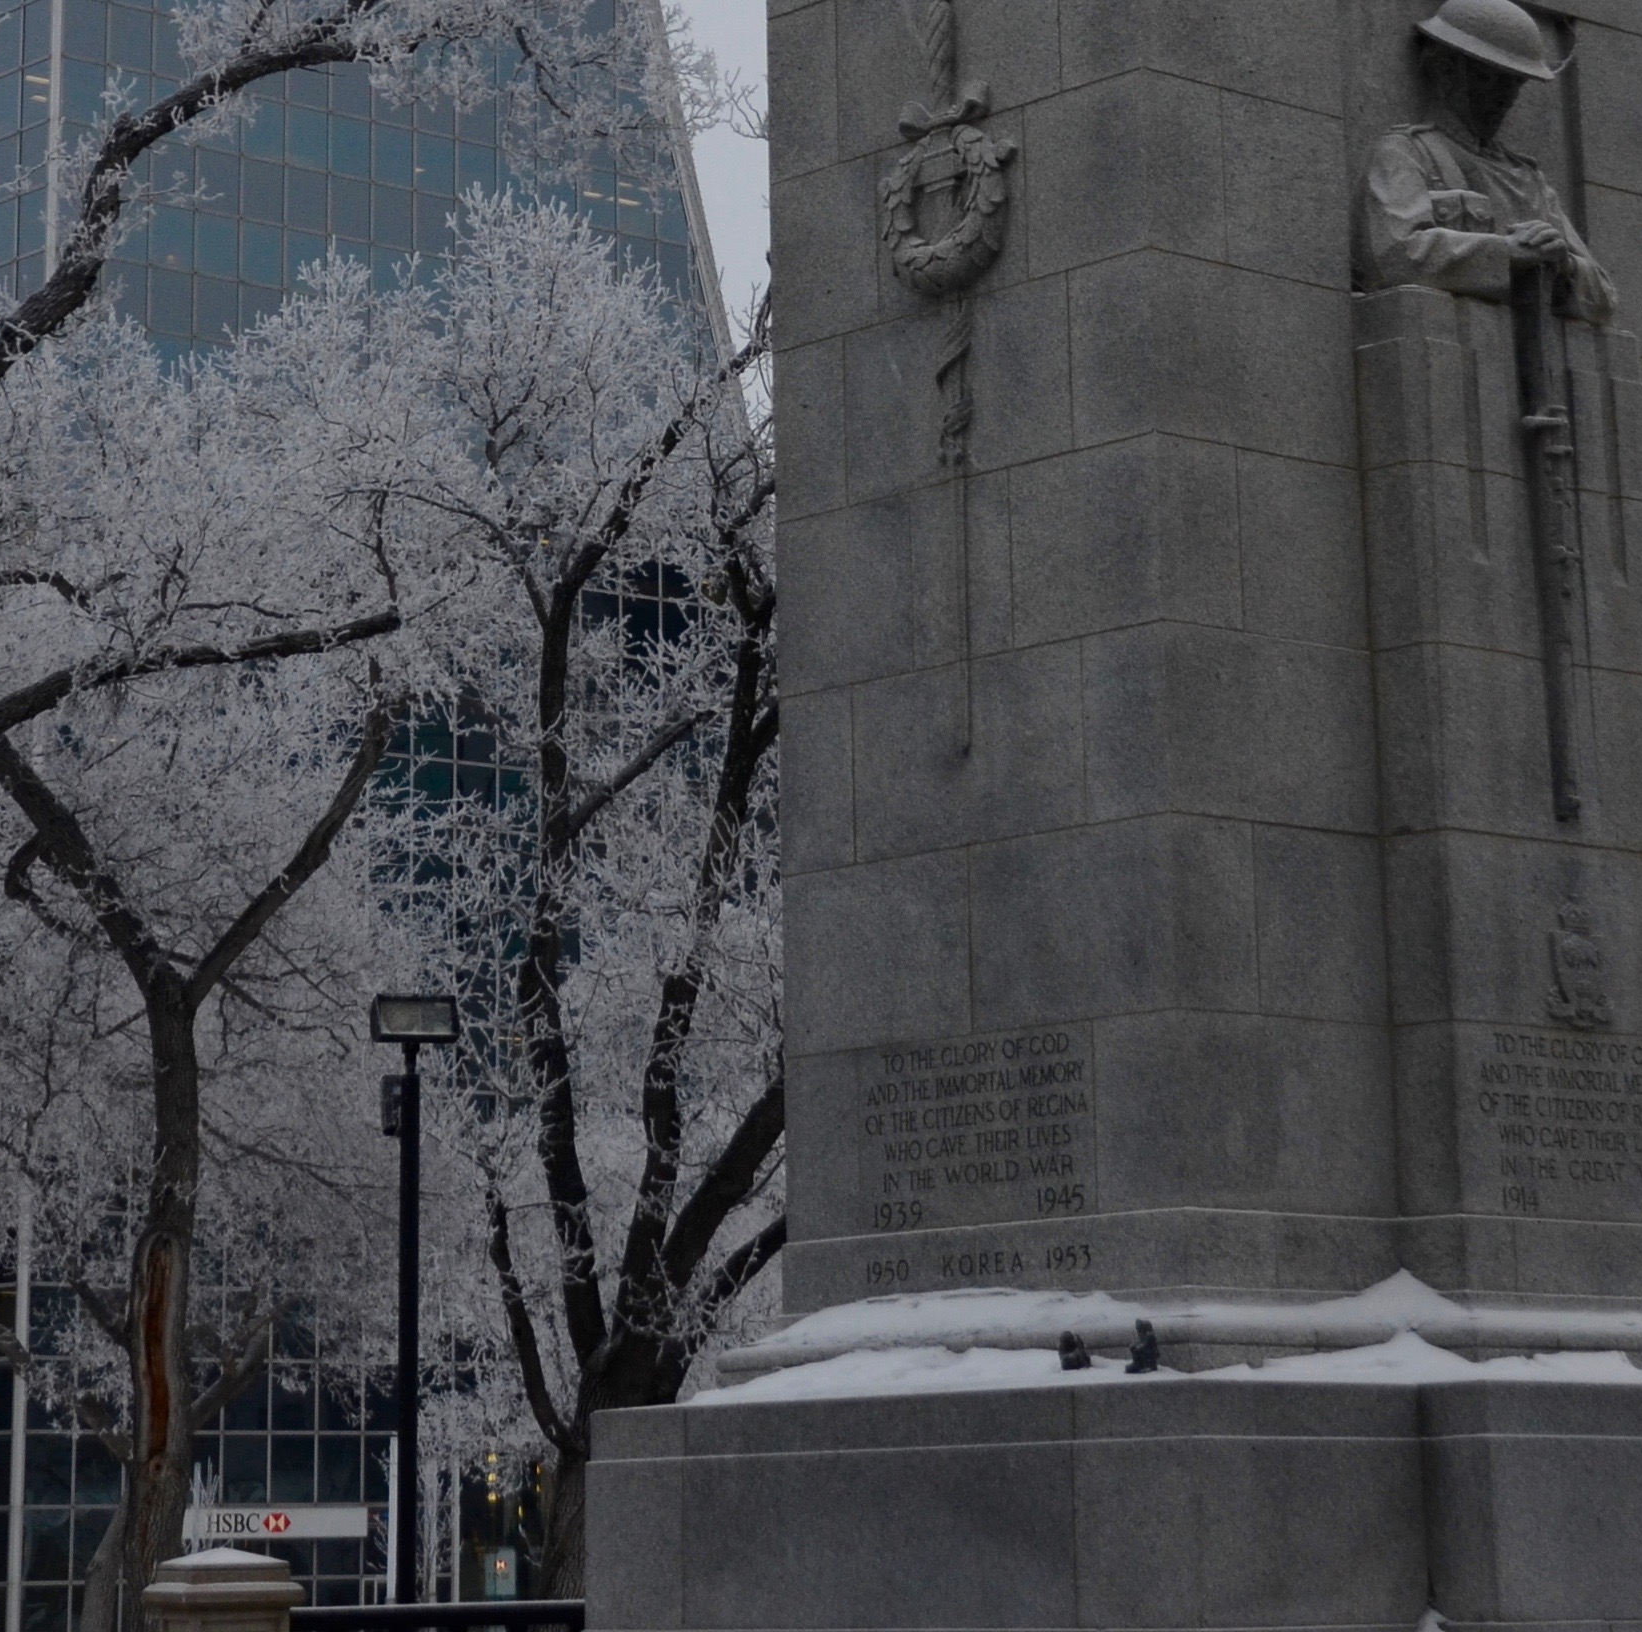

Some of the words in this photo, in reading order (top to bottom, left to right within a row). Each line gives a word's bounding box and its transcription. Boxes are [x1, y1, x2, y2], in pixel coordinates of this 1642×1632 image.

[882, 1052, 904, 1074] TO
[907, 1048, 936, 1071] THE
[1002, 1038, 1025, 1060] OF
[1493, 1032, 1514, 1054] TO
[1518, 1035, 1546, 1057] THE
[1608, 1043, 1627, 1063] OF
[867, 1083, 898, 1106] AND
[901, 1078, 931, 1102] THE
[936, 1068, 1015, 1099] IMMORTAL
[1019, 1059, 1085, 1087] MEMORY
[1480, 1062, 1510, 1084] AND
[1514, 1064, 1543, 1087] THE
[1547, 1067, 1621, 1093] IMMORTAL
[865, 1114, 885, 1136] OF
[890, 1111, 917, 1133] THE
[923, 1102, 995, 1129] CITIZENS
[999, 1098, 1021, 1121] OF
[1478, 1093, 1498, 1114] OF
[1503, 1093, 1530, 1117] THE
[1536, 1096, 1604, 1121] CITIZENS
[1607, 1101, 1627, 1123] OF
[884, 1140, 922, 1162] WHO
[974, 1128, 1019, 1154] THEIR
[1027, 1123, 1072, 1148] LIVES
[1498, 1123, 1535, 1147] WHO
[1584, 1129, 1628, 1153] THEIR
[883, 1172, 899, 1194] IN
[909, 1168, 936, 1191] THE
[944, 1159, 1020, 1185] WORLD
[1030, 1154, 1074, 1177] WAR
[1500, 1154, 1517, 1177] IN
[1527, 1156, 1559, 1180] THE
[874, 1200, 922, 1229] 1939
[1037, 1183, 1086, 1214] 1945
[1502, 1185, 1539, 1212] 1914
[866, 1259, 910, 1286] 1950
[942, 1250, 1024, 1278] KOREA
[1046, 1243, 1092, 1271] 1953
[206, 1513, 260, 1534] HSBC
